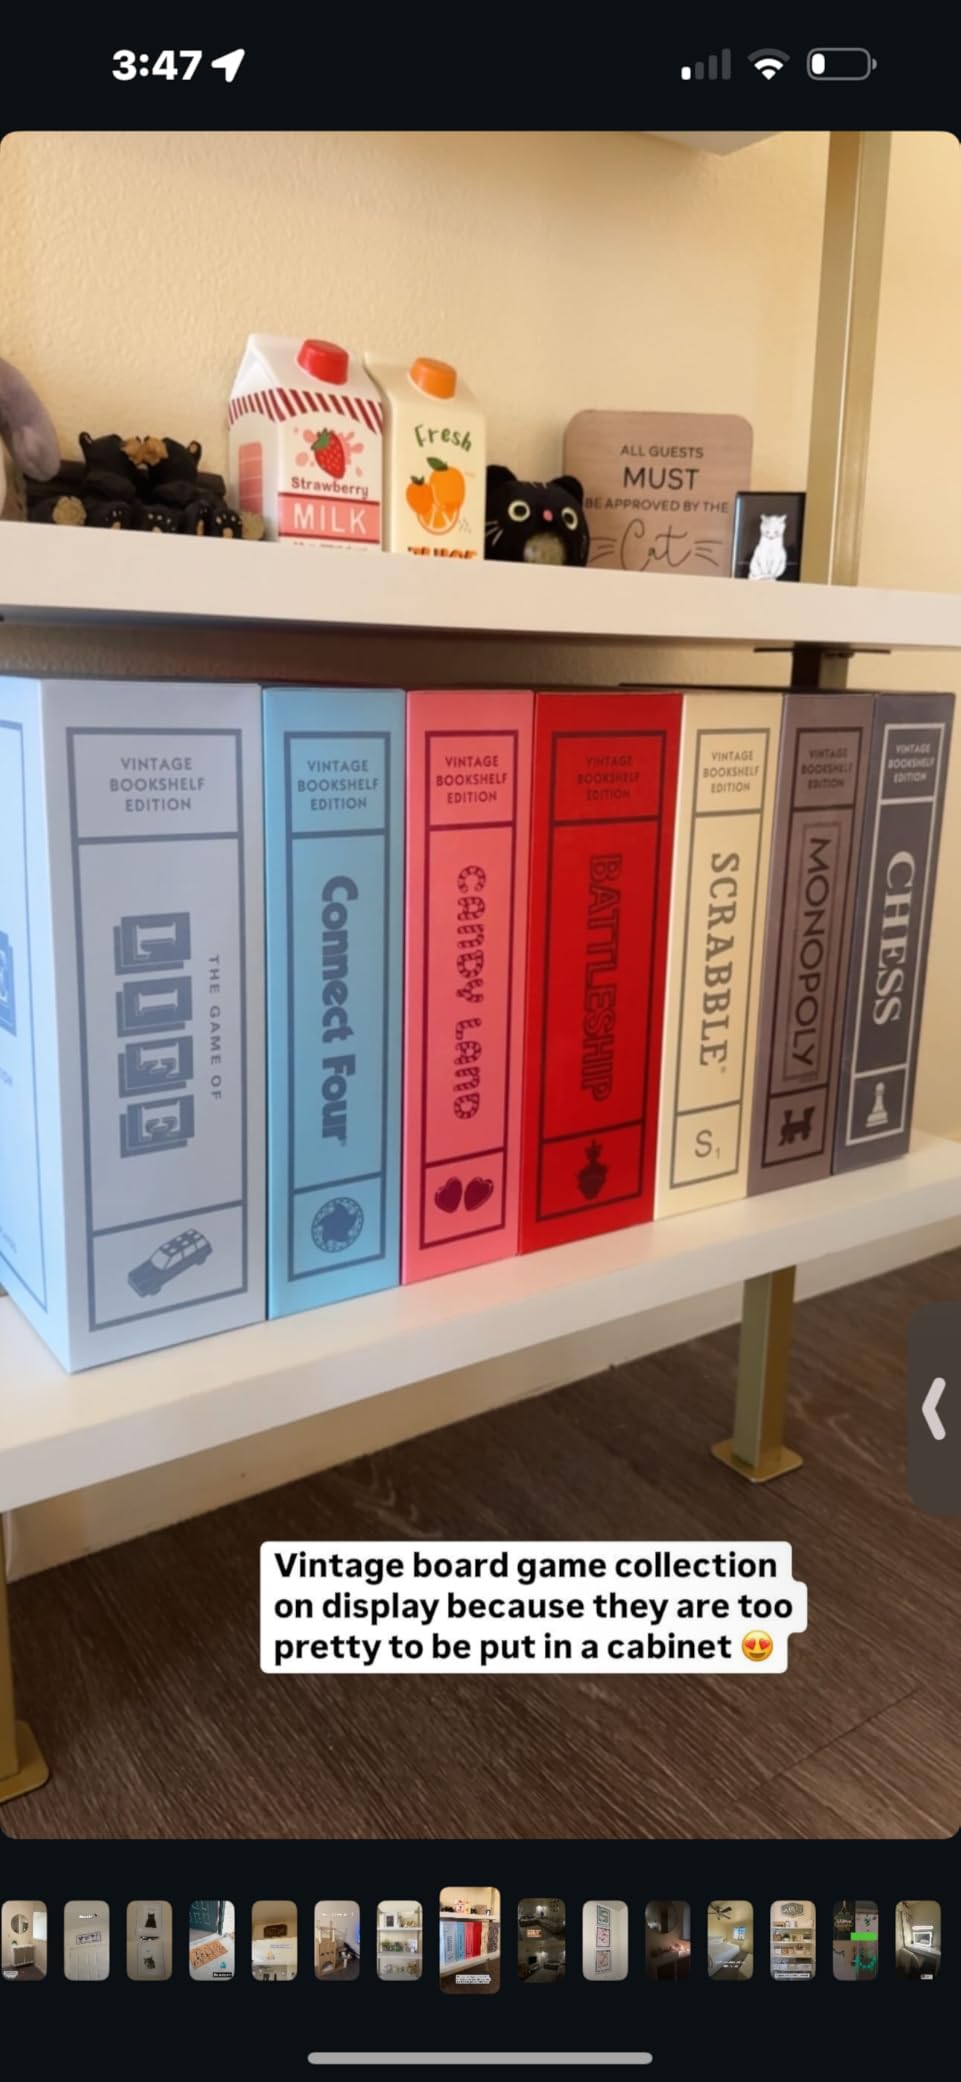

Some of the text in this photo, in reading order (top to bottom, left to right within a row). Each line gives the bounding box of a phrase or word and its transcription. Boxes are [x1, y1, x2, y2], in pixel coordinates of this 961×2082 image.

[112, 49, 203, 81] 3:47
[415, 423, 473, 453] Fresh
[620, 445, 704, 459] ALL GUESTS
[623, 466, 700, 490] MUST
[291, 476, 369, 500] Strawberry
[585, 498, 729, 513] BE APPROVED BY THE
[293, 503, 367, 535] MILK
[620, 518, 692, 571] Cat
[808, 748, 848, 759] VINTAGE
[895, 743, 931, 754] VINTAGE
[445, 755, 499, 768] VINTAGE
[585, 755, 633, 767] VINTAGE
[711, 750, 754, 762] VINTAGE
[888, 757, 935, 769] BOOKSHELF
[120, 757, 193, 772] VINTAGE
[307, 760, 369, 773] VINTAGE
[801, 763, 853, 775] BOOKSHELF
[436, 772, 508, 786] BOOKSHELF
[577, 772, 640, 785] BOOKSHELF
[703, 766, 760, 779] BOOKSHELF
[893, 772, 927, 784] EDITION
[109, 777, 206, 793] BOOKSHELF
[297, 778, 380, 792] BOOKSHELF
[711, 782, 751, 794] EDITION
[807, 779, 845, 790] EDITION
[447, 791, 497, 804] EDITION
[586, 788, 630, 801] EDITION
[125, 797, 192, 813] EDITION
[310, 797, 368, 811] EDITION
[873, 850, 916, 1025] CHESS
[792, 837, 832, 1067] MONOPOLY
[580, 852, 623, 1104] BATTLESHIP
[321, 875, 358, 1141] Connect Four
[208, 953, 222, 1100] THE GAME OF
[113, 912, 195, 1159] LIFE
